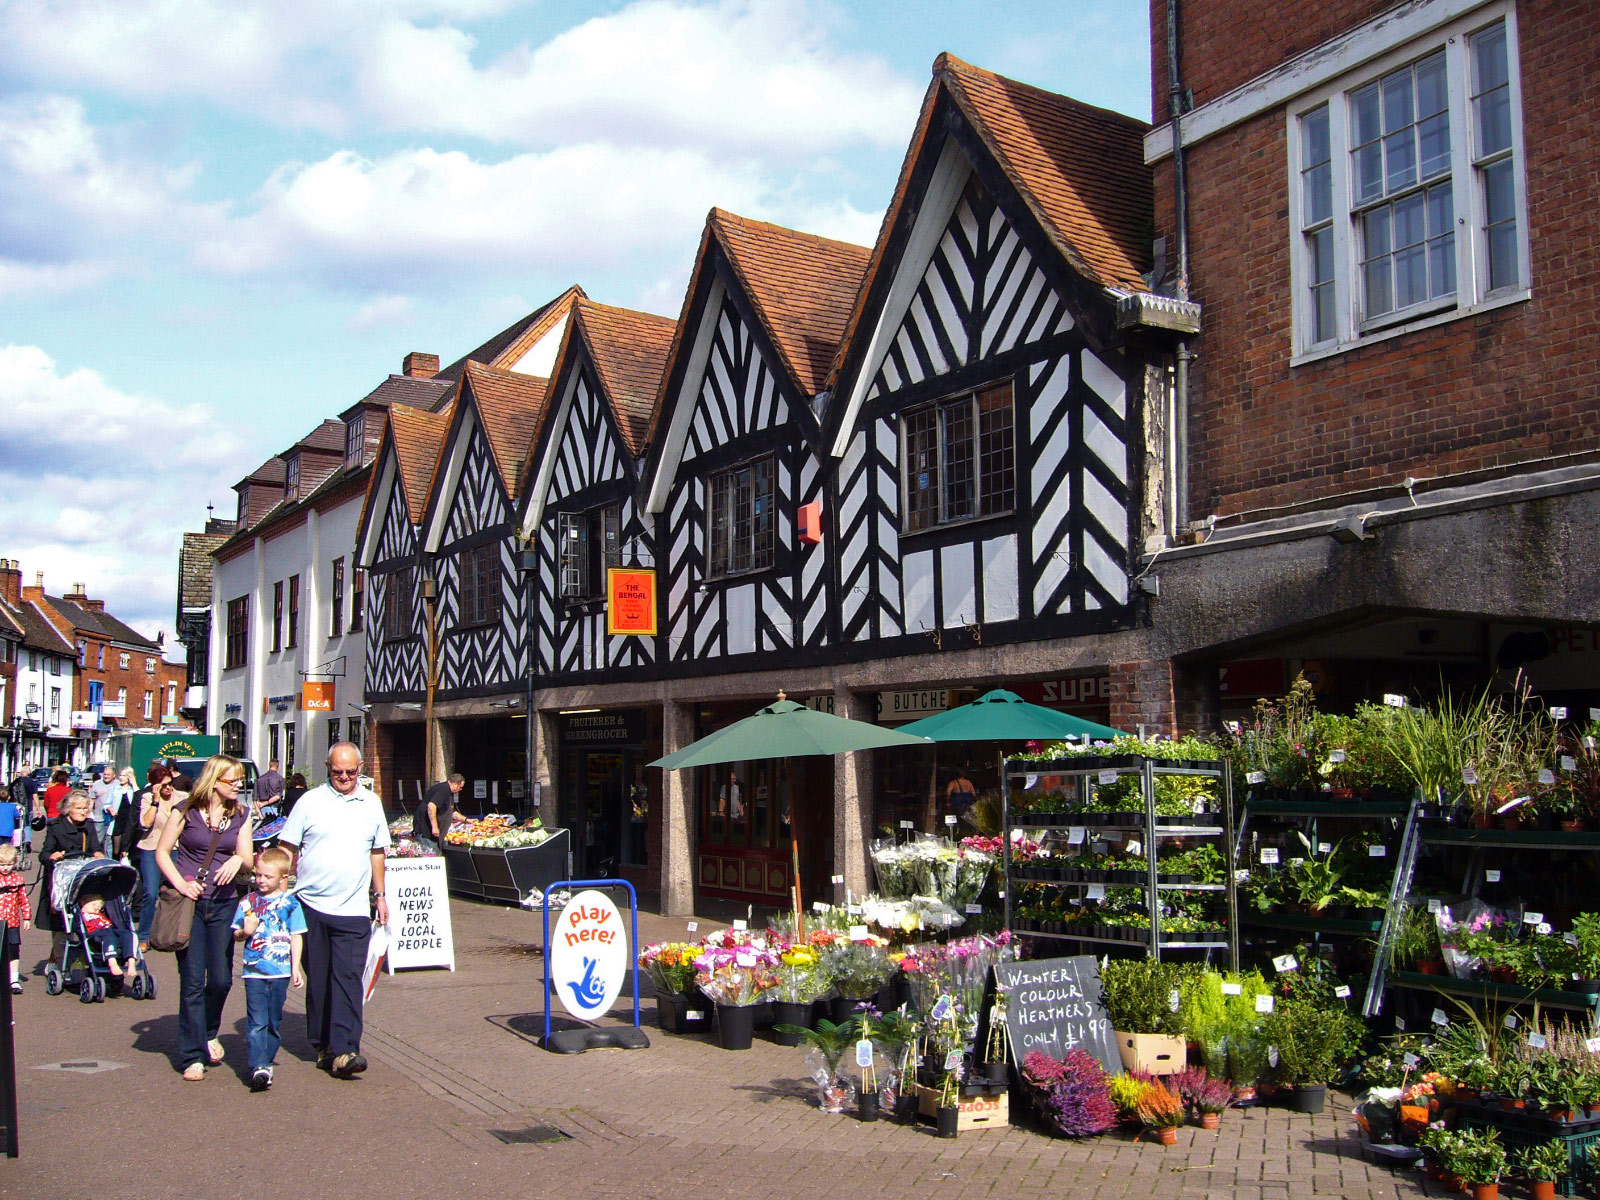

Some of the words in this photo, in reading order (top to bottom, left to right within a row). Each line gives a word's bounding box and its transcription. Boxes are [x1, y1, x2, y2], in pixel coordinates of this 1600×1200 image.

[625, 584, 640, 592] THE
[618, 592, 647, 600] BENGAL
[1042, 676, 1110, 702] SUPE
[894, 691, 946, 710] BUTCHE
[569, 715, 616, 727] FRUITERER
[617, 714, 625, 725] &
[565, 728, 628, 740] GREENGROCER
[398, 886, 433, 898] LOCAL
[399, 899, 434, 911] NEWS
[406, 912, 429, 923] FOR
[569, 905, 612, 928] play
[401, 925, 436, 937] LOCAL
[564, 928, 616, 947] here!
[397, 938, 442, 951] PEOPLE
[1020, 984, 1084, 1004] COLOUR
[1023, 1025, 1057, 1047] ONLY
